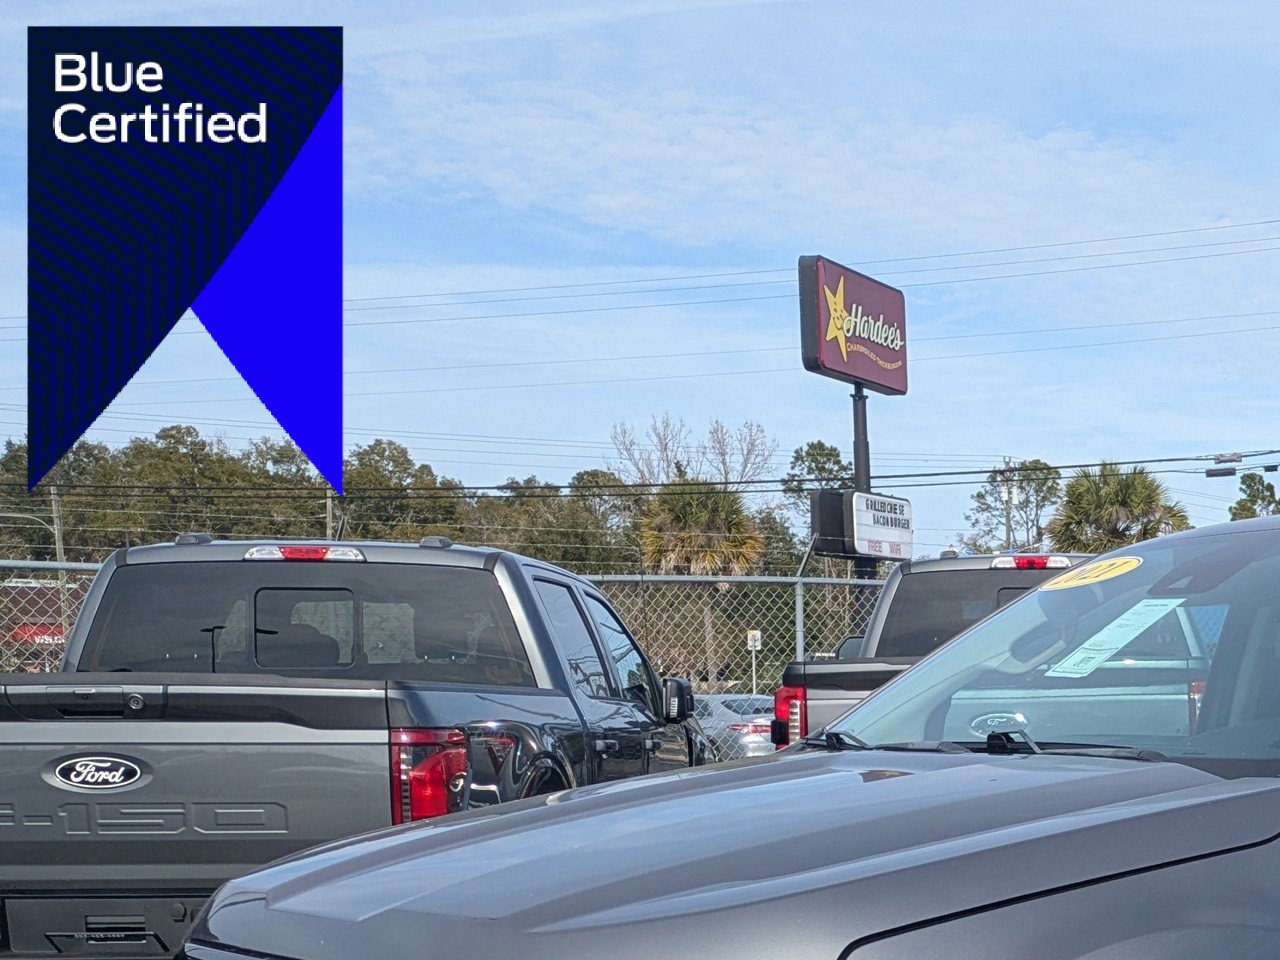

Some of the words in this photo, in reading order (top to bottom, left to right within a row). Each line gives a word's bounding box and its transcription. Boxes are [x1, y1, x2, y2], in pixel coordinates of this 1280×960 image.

[843, 303, 904, 351] Hardee's
[865, 498, 886, 513] GRILLED
[872, 513, 889, 527] BACON
[890, 516, 910, 530] BURGER
[868, 540, 882, 553] FREE
[70, 761, 127, 784] Ford
